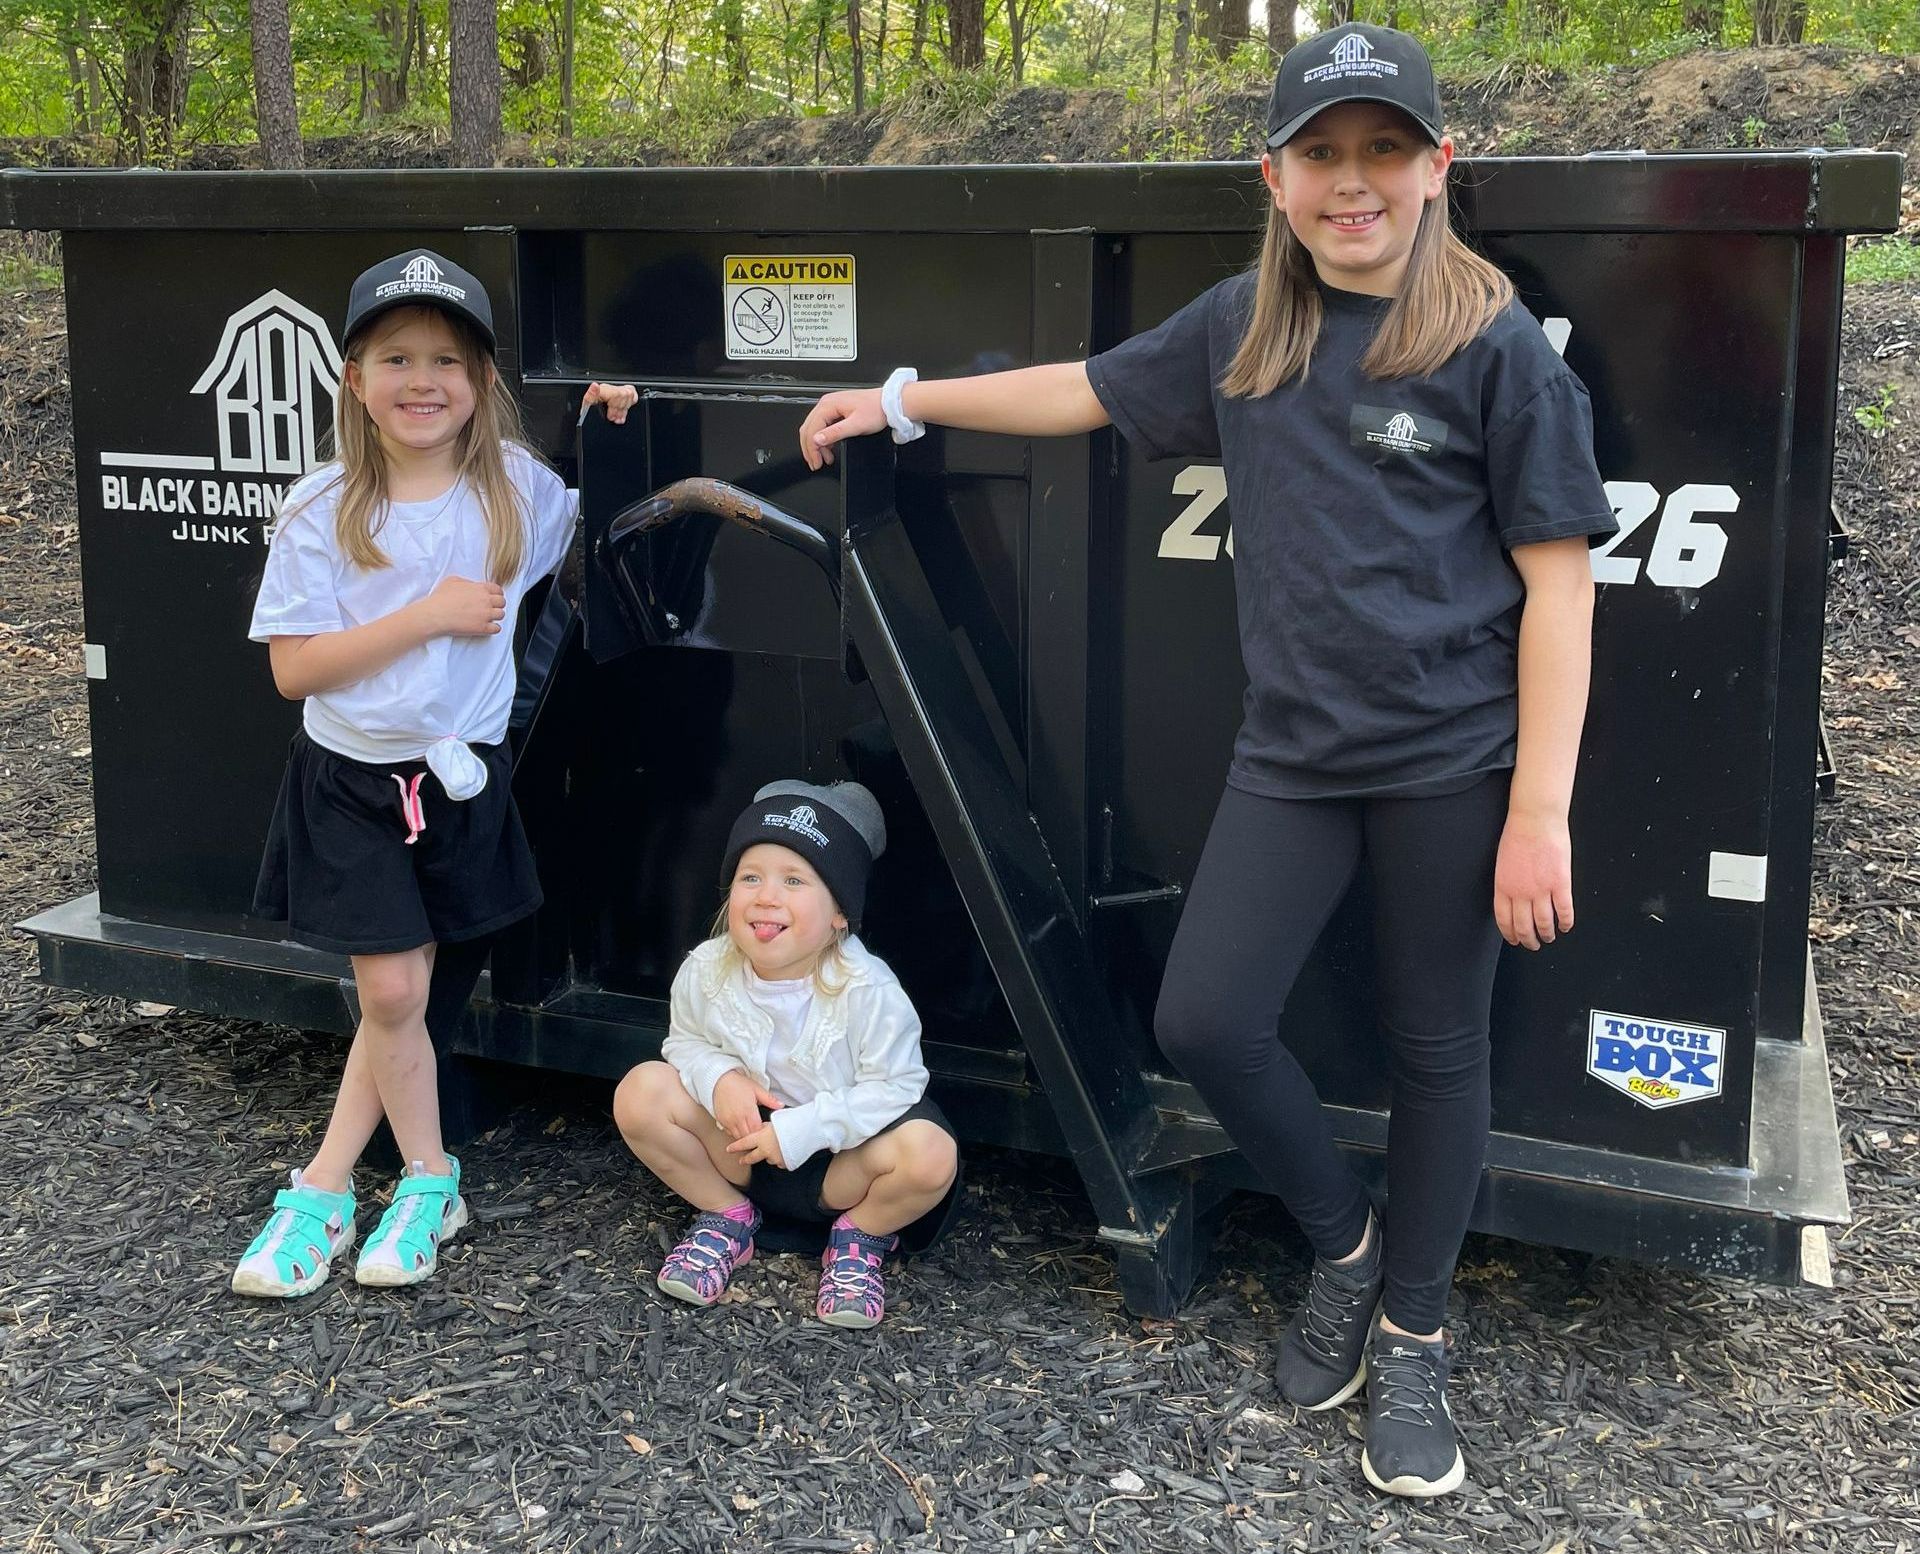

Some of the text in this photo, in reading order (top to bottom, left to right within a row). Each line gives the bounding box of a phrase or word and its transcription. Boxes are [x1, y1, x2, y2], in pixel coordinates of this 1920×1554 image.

[1303, 62, 1398, 83] BLACK BARN DUMPSTERS
[1321, 70, 1383, 82] JUNK REMOVAL
[750, 262, 848, 279] CAUTION
[375, 283, 400, 297] BLACK
[422, 282, 465, 300] DUMPSTERS
[384, 288, 458, 301] JUNK REMOVAL
[793, 293, 835, 301] KEEP OFF!
[800, 310, 821, 318] occupy
[1366, 435, 1383, 443] BLACK
[1383, 437, 1398, 446] BARN
[1397, 440, 1431, 453] DUMPSTERS
[101, 475, 197, 514] BLACK
[201, 480, 283, 518] BARN
[172, 520, 250, 545] JUNK
[1605, 1019, 1711, 1051] TOUGH
[1594, 1036, 1718, 1088] BOX
[1628, 1076, 1680, 1099] Bucks
